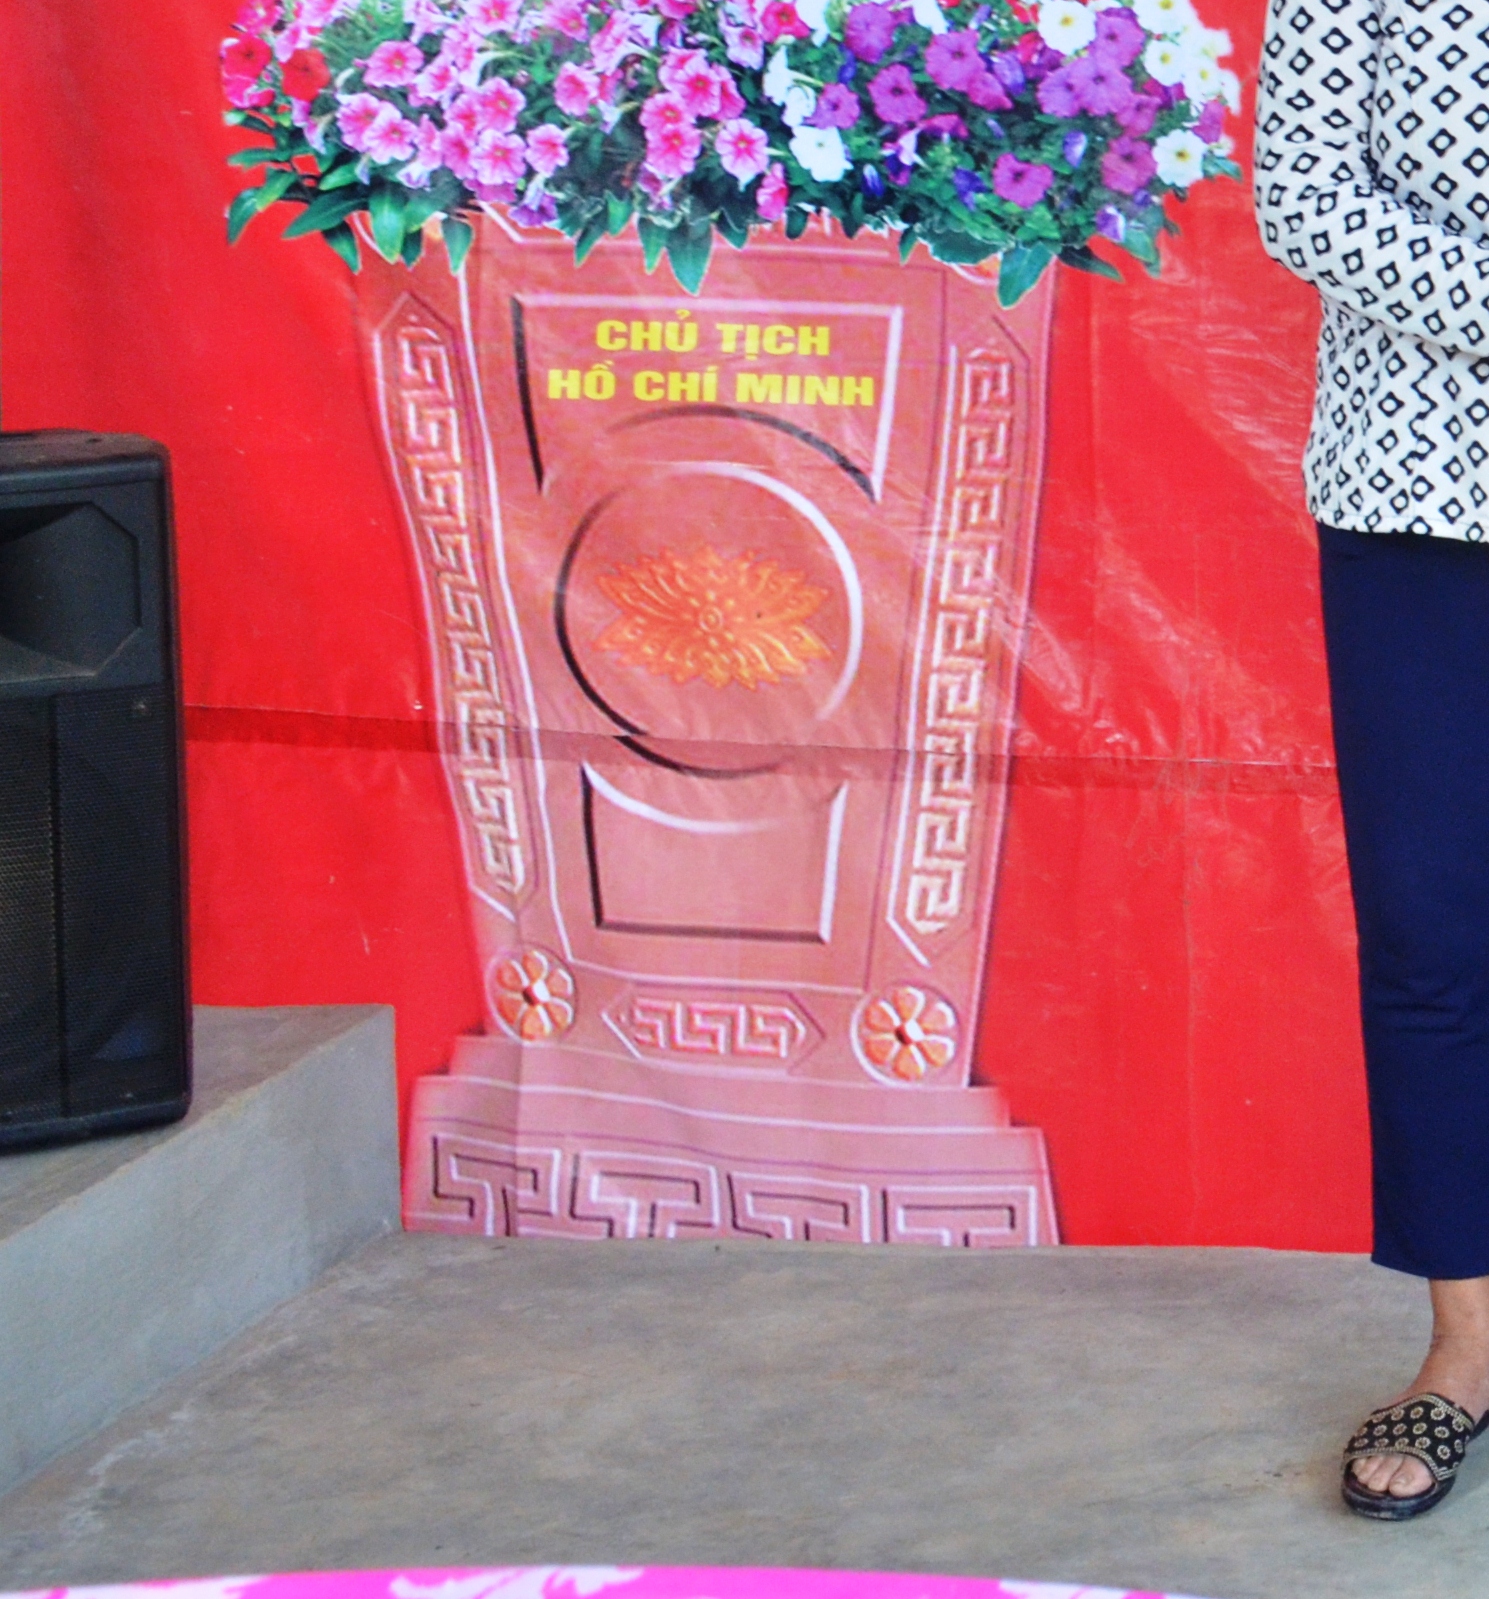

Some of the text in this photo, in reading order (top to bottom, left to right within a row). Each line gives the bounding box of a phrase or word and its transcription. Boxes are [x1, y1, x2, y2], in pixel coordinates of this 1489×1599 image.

[596, 309, 830, 361] CHỦ TỊCH
[547, 360, 874, 406] HỒ CHÍ MINH
